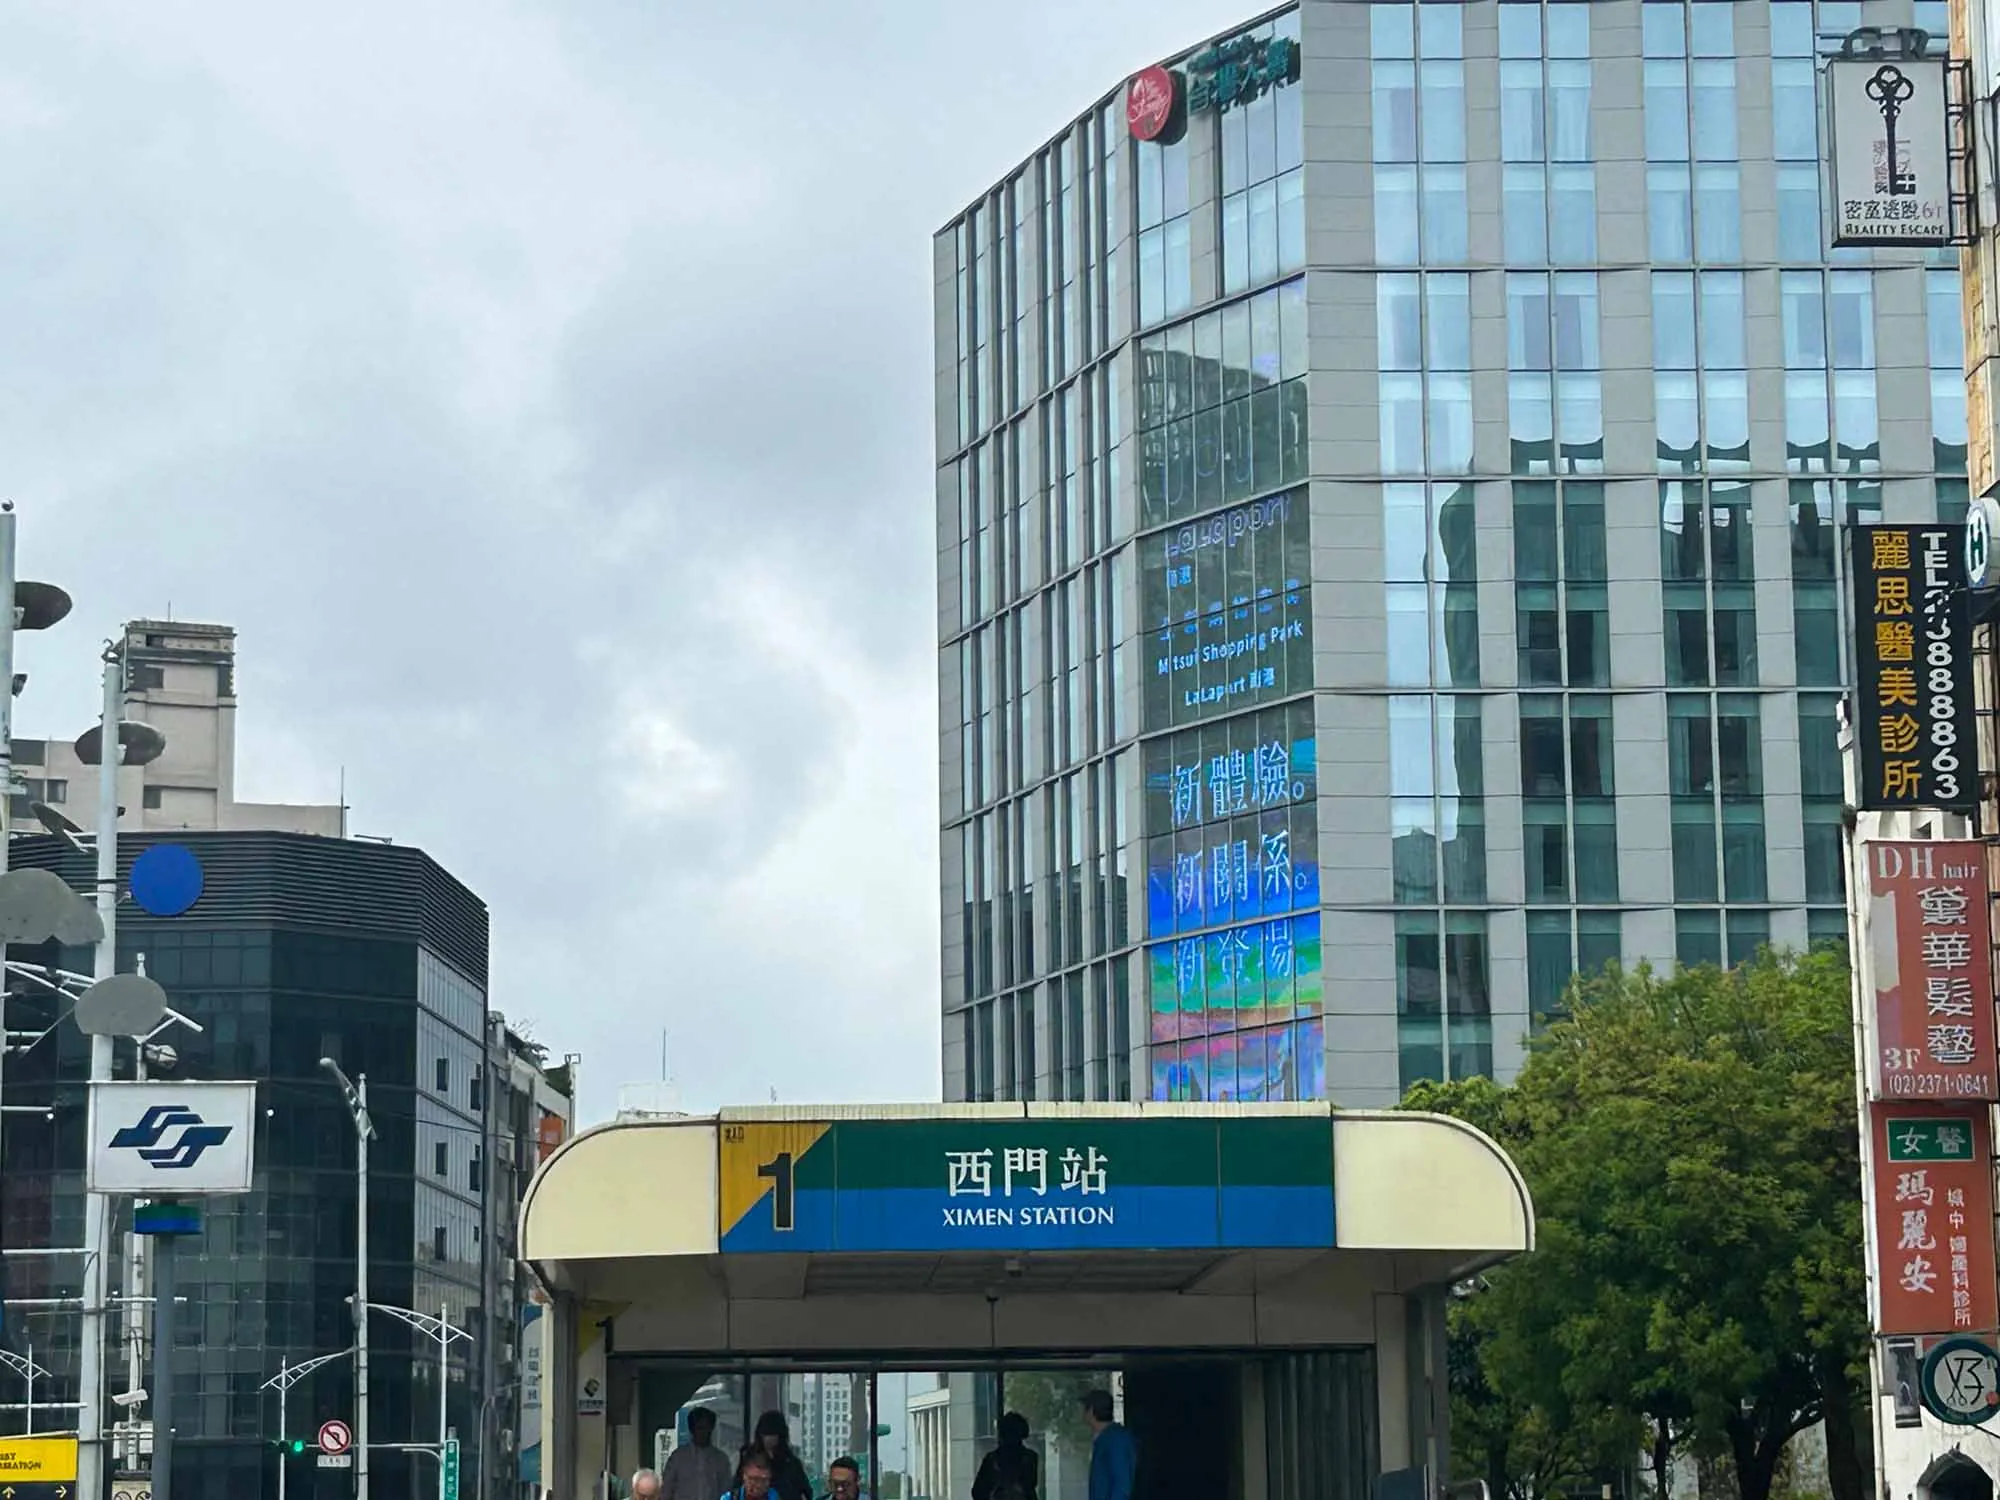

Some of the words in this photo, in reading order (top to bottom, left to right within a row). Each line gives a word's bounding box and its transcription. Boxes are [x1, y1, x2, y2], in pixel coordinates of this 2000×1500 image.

[1871, 531, 1922, 800] 麗思醫美診所
[1884, 1047, 1921, 1071] 3F
[1896, 1126, 1967, 1154] 女醫
[757, 1151, 794, 1231] 1
[945, 1146, 1109, 1197] 西門站
[942, 1207, 1013, 1227] XIMEN
[1020, 1206, 1114, 1226] STATION
[1896, 1169, 1938, 1294] 瑪麗安
